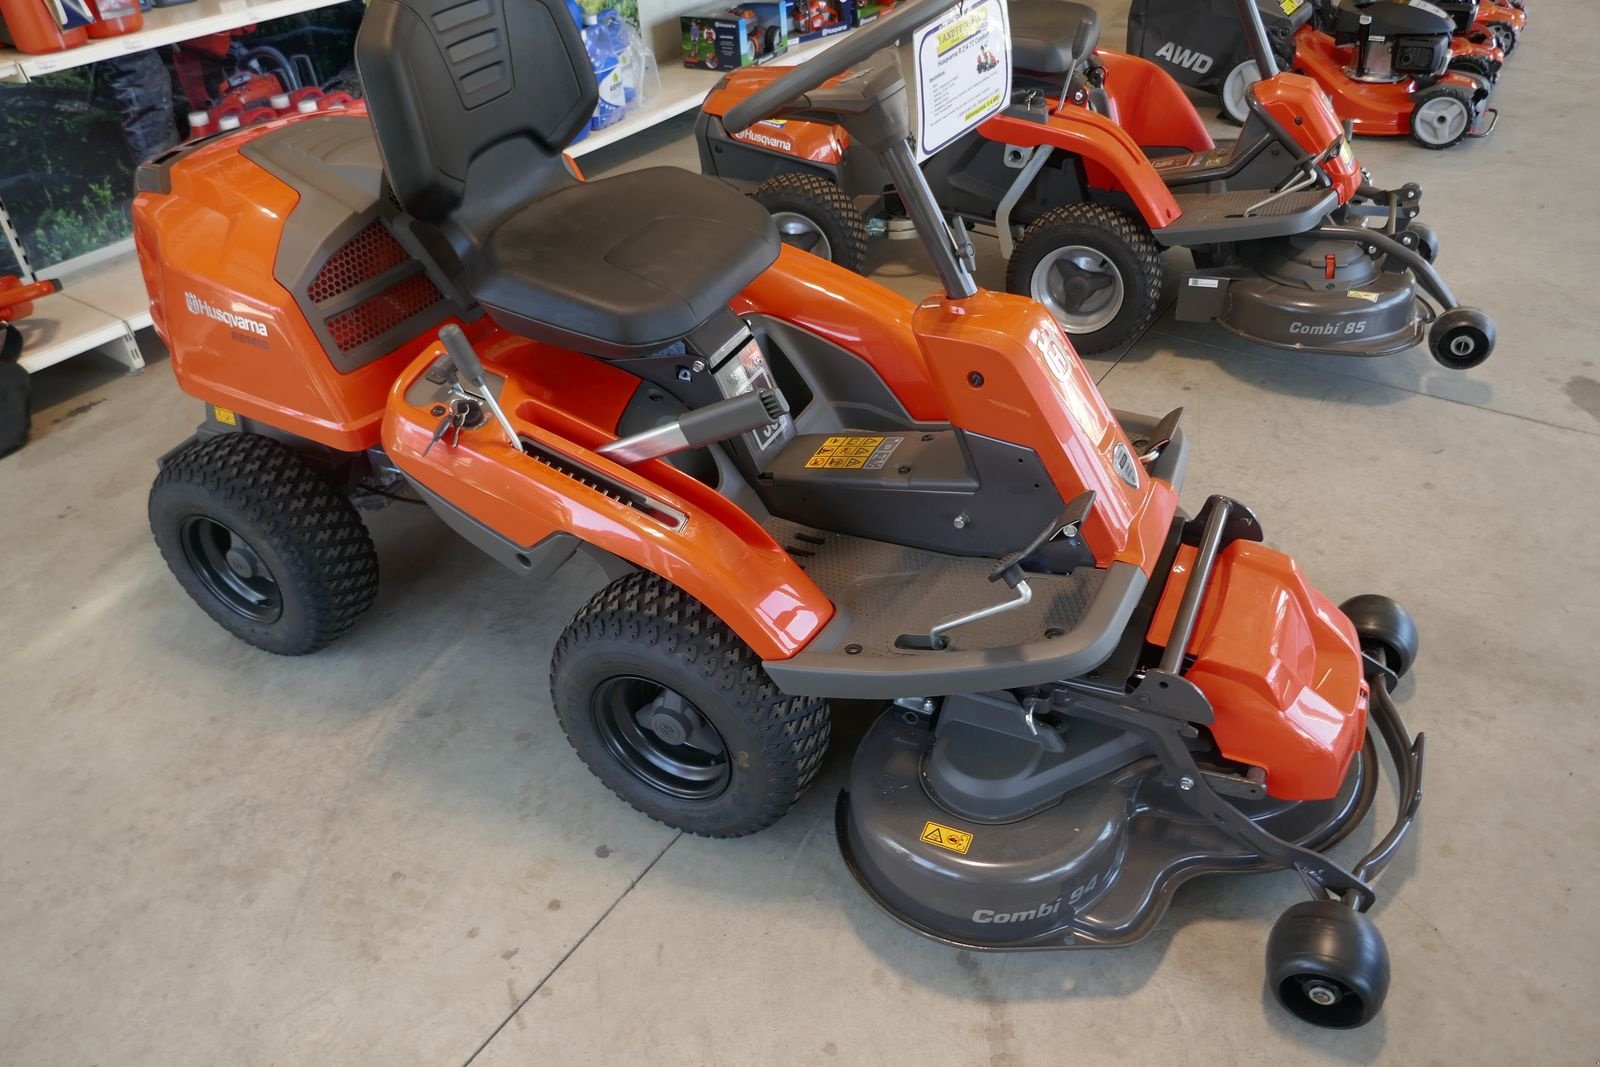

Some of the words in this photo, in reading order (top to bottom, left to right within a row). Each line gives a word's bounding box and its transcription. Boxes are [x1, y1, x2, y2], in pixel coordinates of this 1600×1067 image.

[1155, 41, 1214, 74] AWD
[745, 129, 791, 151] Husqvarna
[199, 299, 268, 336] Husqvarna
[1344, 321, 1366, 334] 85
[972, 897, 1062, 924] Combi
[1068, 873, 1099, 905] 94
